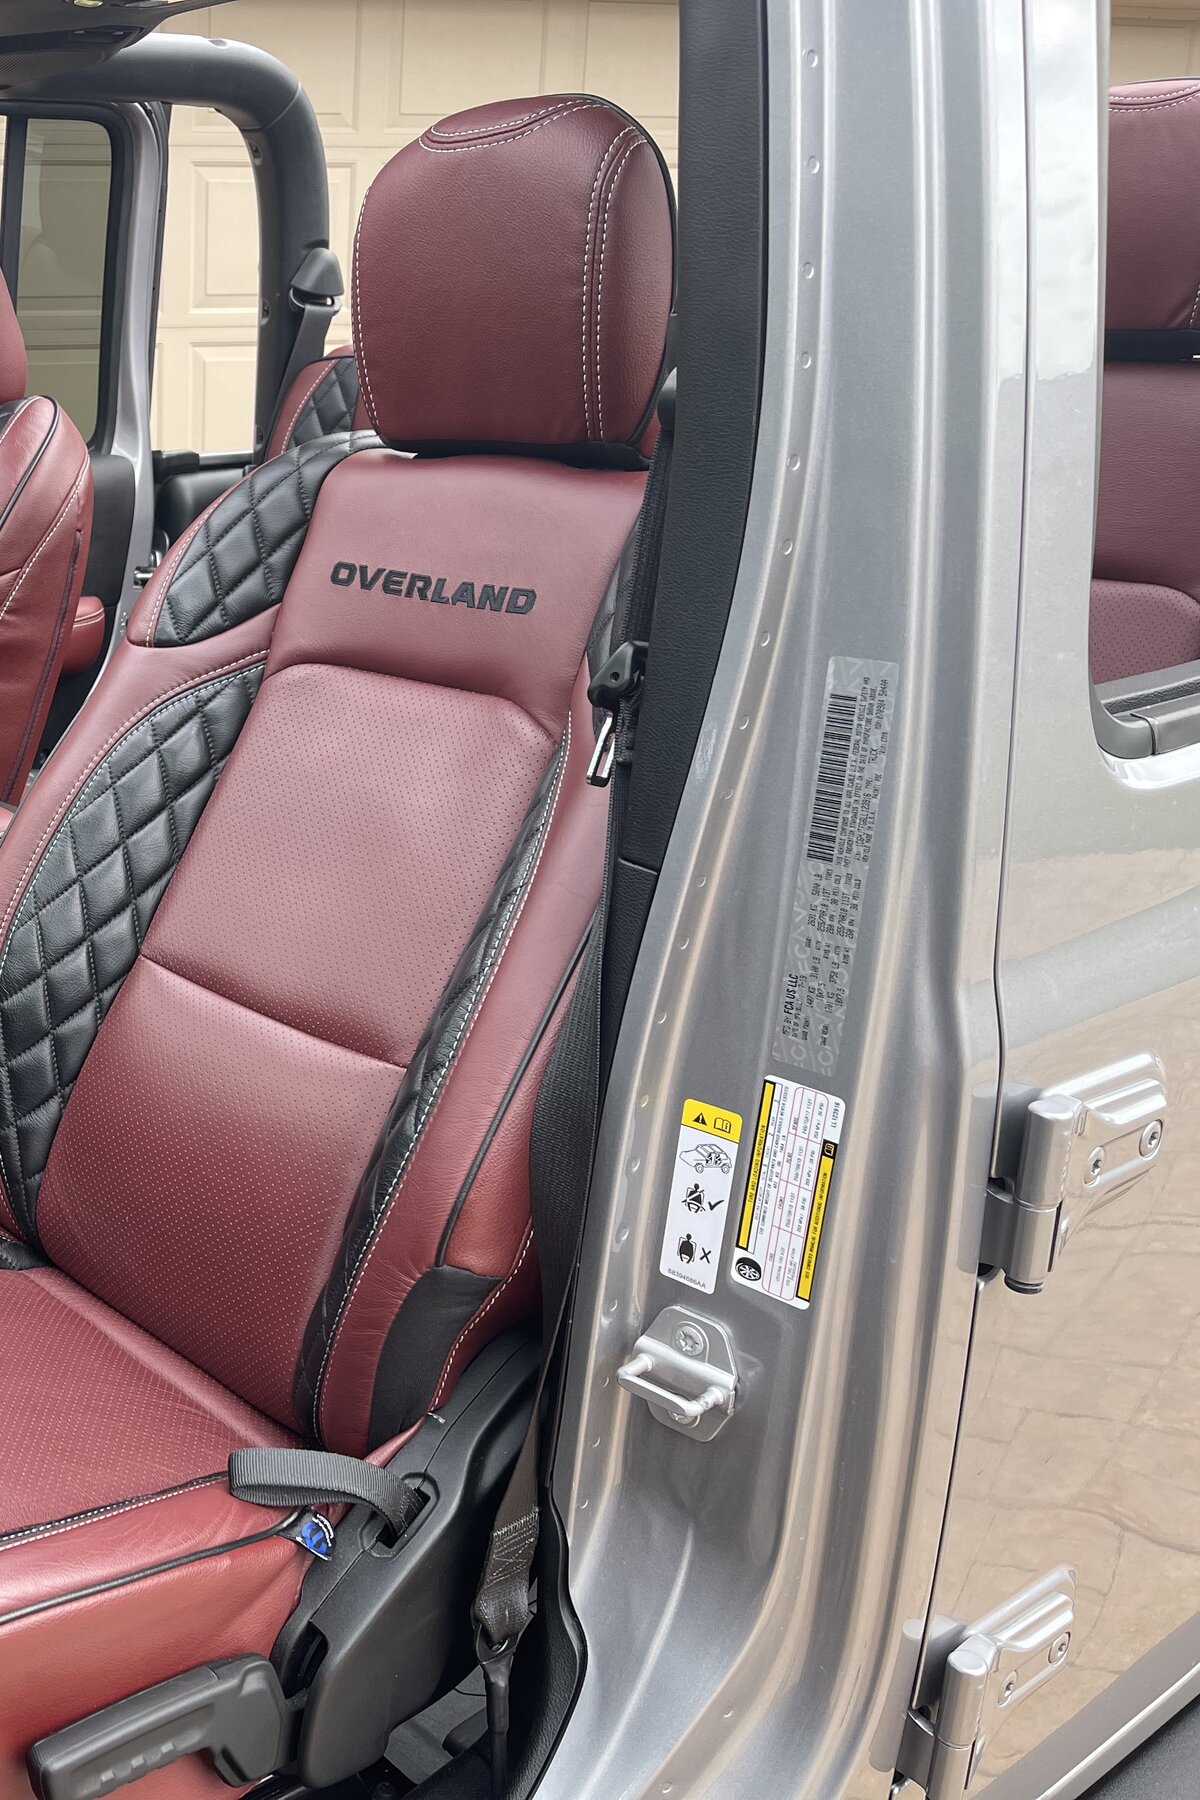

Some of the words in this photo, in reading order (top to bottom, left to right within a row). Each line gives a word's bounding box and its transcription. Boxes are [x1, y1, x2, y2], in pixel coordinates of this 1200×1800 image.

[330, 561, 537, 614] OVERLAND
[860, 687, 869, 702] SAFETY
[857, 704, 866, 722] VEHICLE
[852, 738, 861, 756] FEDERAL
[868, 748, 879, 764] TRUCK
[846, 774, 856, 798] APPLICABLE
[846, 830, 856, 854] PREVENTION
[854, 783, 863, 798] EFFECT
[837, 838, 846, 855] VEHICLE
[863, 846, 871, 862] VEHICLE
[814, 873, 822, 881] LB
[822, 888, 831, 901] 113T
[810, 904, 818, 912] KG
[808, 914, 817, 927] 2631
[827, 991, 835, 999] KG
[841, 892, 851, 906] 113T
[812, 956, 821, 964] LB
[788, 973, 798, 988] LLC
[786, 989, 796, 1000] US
[808, 986, 817, 994] KG
[784, 1000, 794, 1015] FCA
[756, 1125, 766, 1158] INFORMATION
[819, 1172, 828, 1202] INFORMATION
